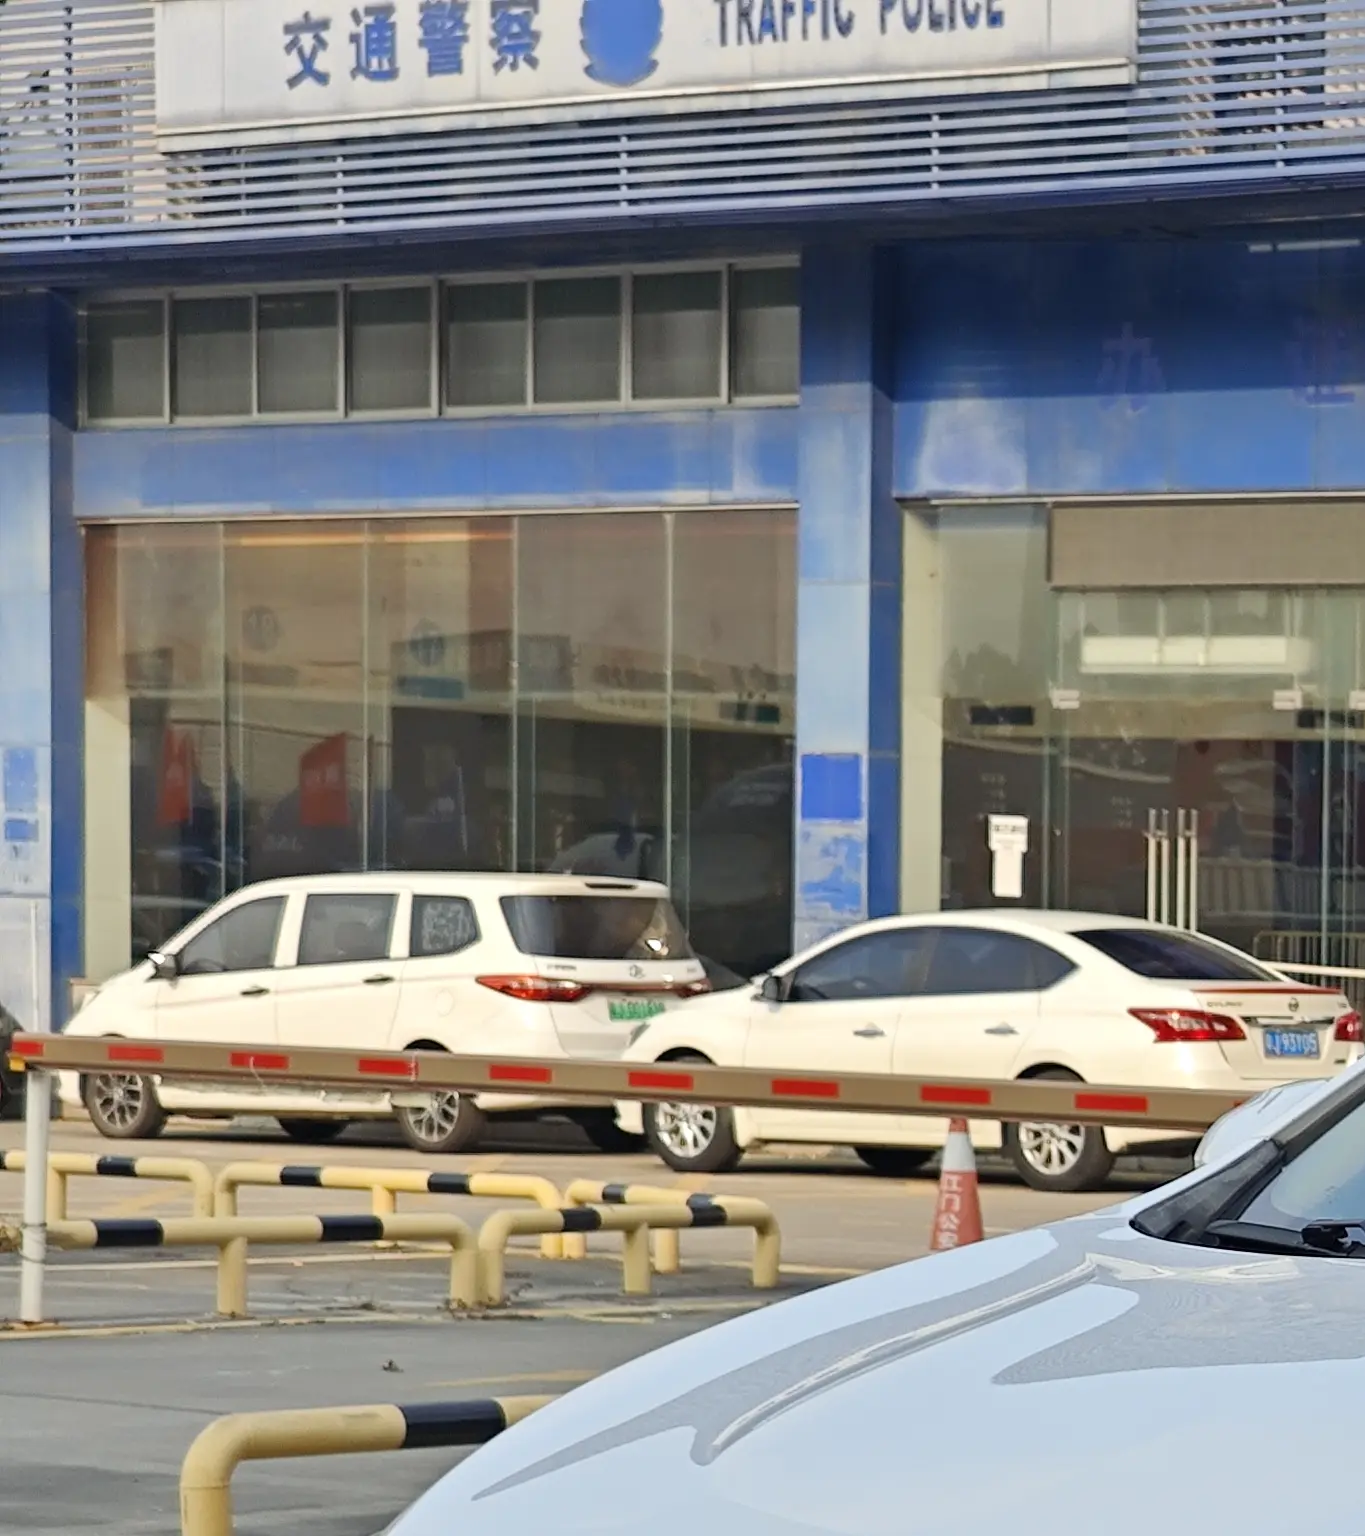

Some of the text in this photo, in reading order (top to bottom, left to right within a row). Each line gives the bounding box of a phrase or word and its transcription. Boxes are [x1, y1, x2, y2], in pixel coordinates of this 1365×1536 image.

[283, 0, 541, 89] 交通警察
[714, 0, 855, 47] TRAFFIC
